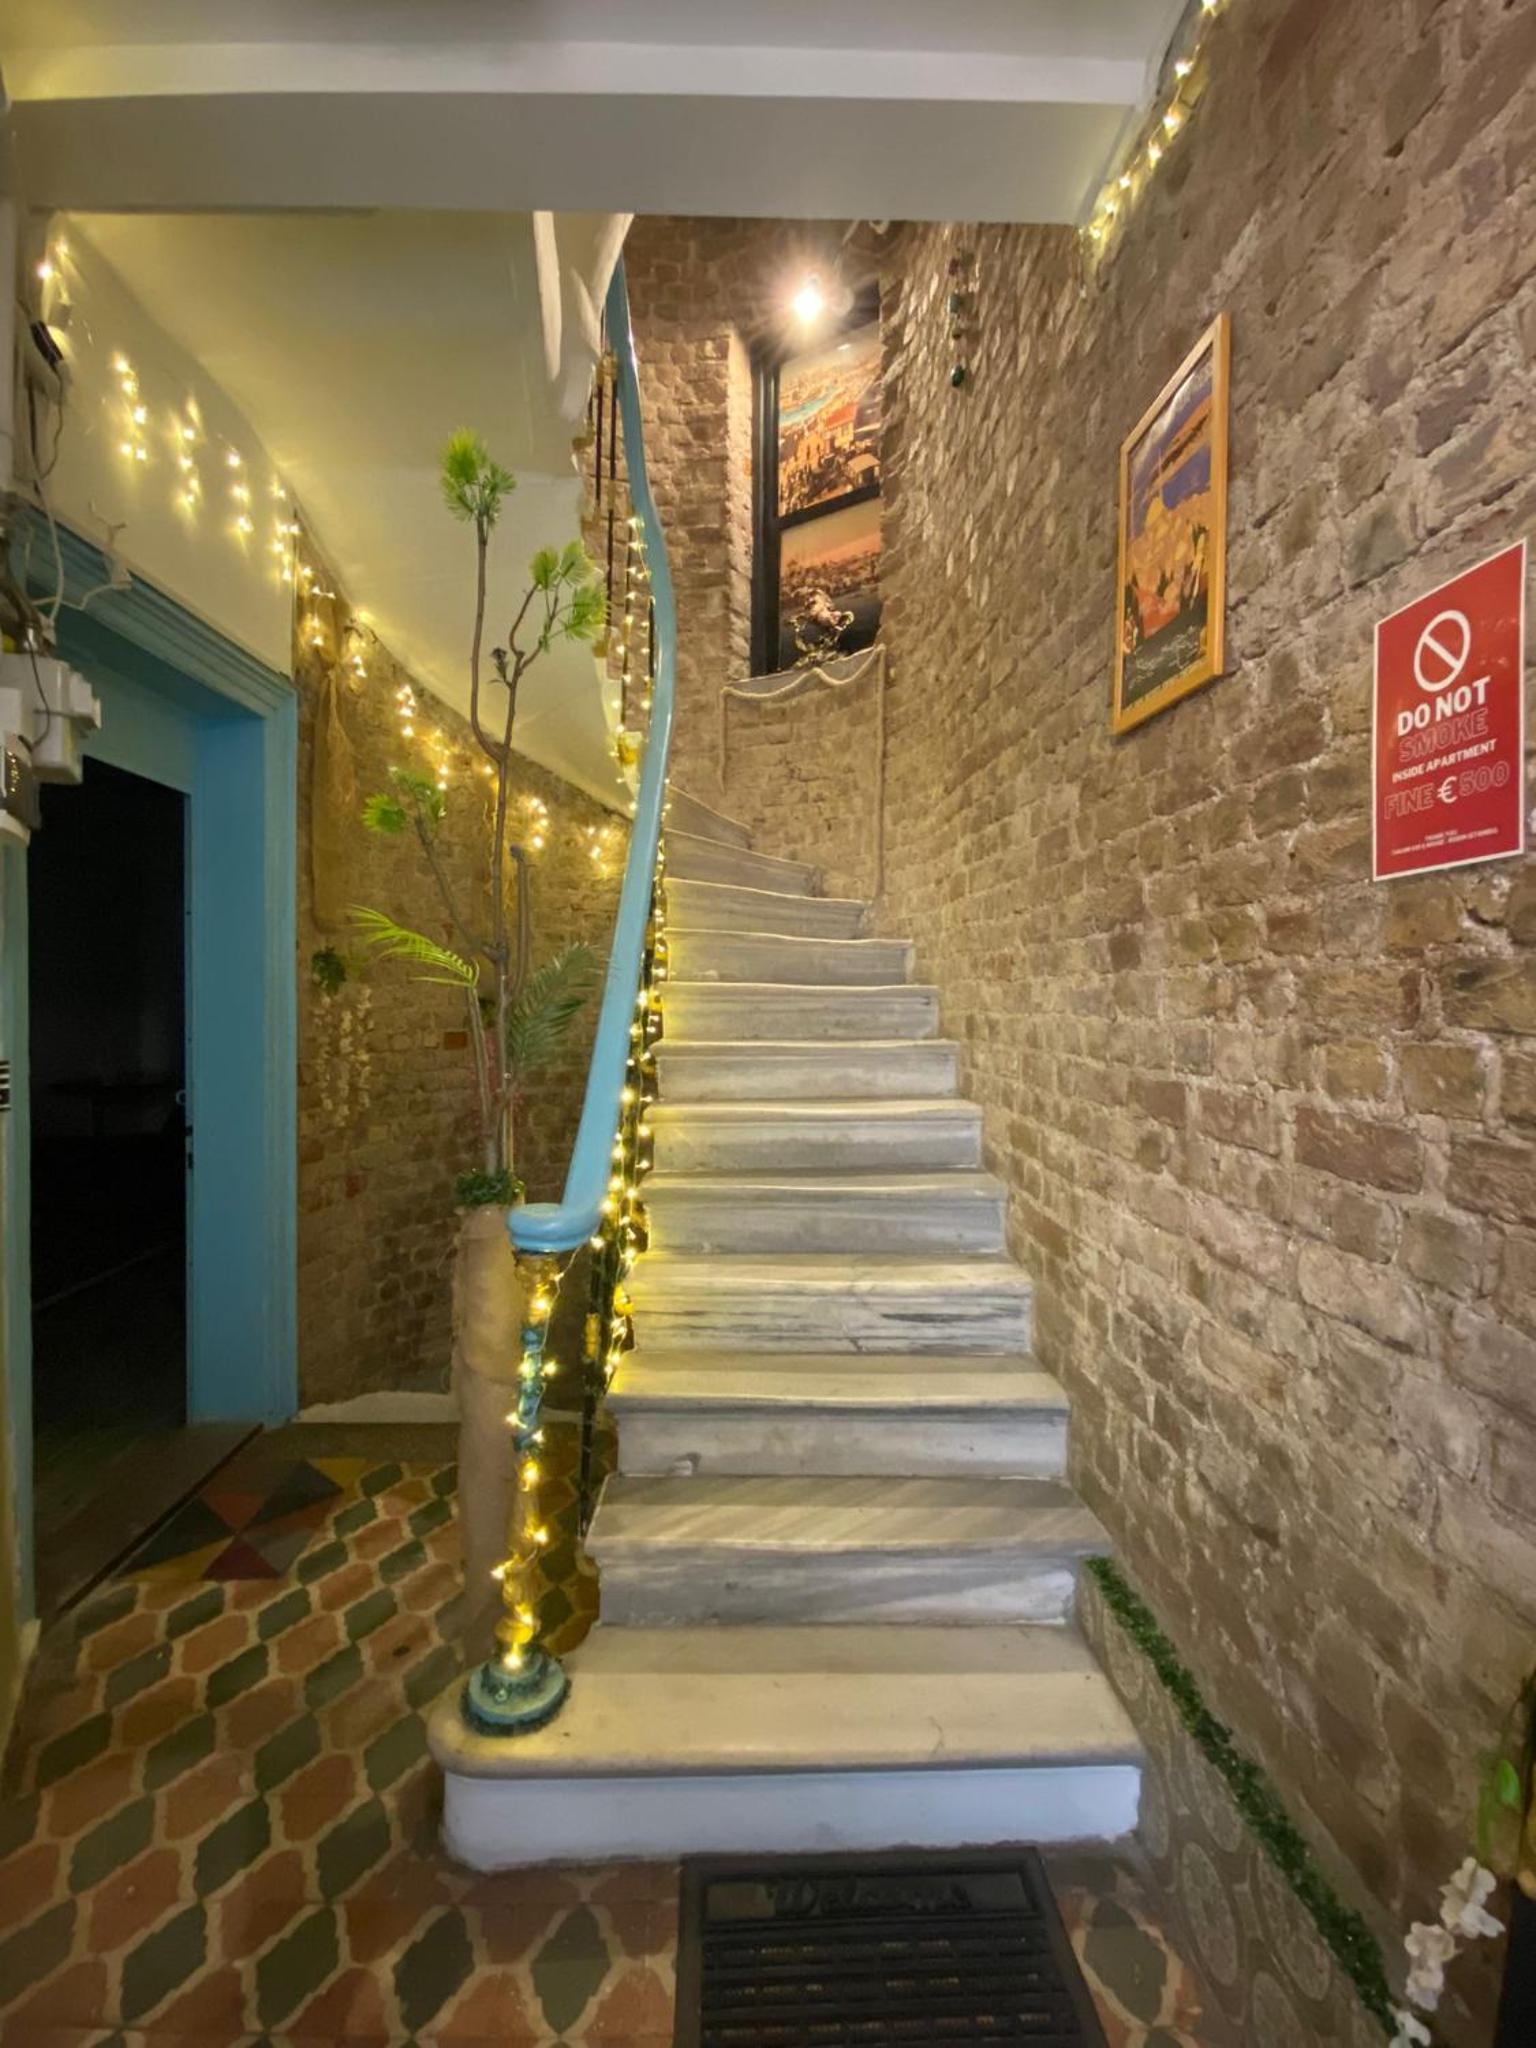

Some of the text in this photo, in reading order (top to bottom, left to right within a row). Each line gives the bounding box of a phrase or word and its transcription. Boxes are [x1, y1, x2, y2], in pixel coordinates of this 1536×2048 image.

[1397, 675, 1491, 737] DO NOT
[1399, 707, 1488, 763] SMOKE
[1392, 738, 1497, 784] INSIDE APARTMENT
[1384, 782, 1434, 820] FINE
